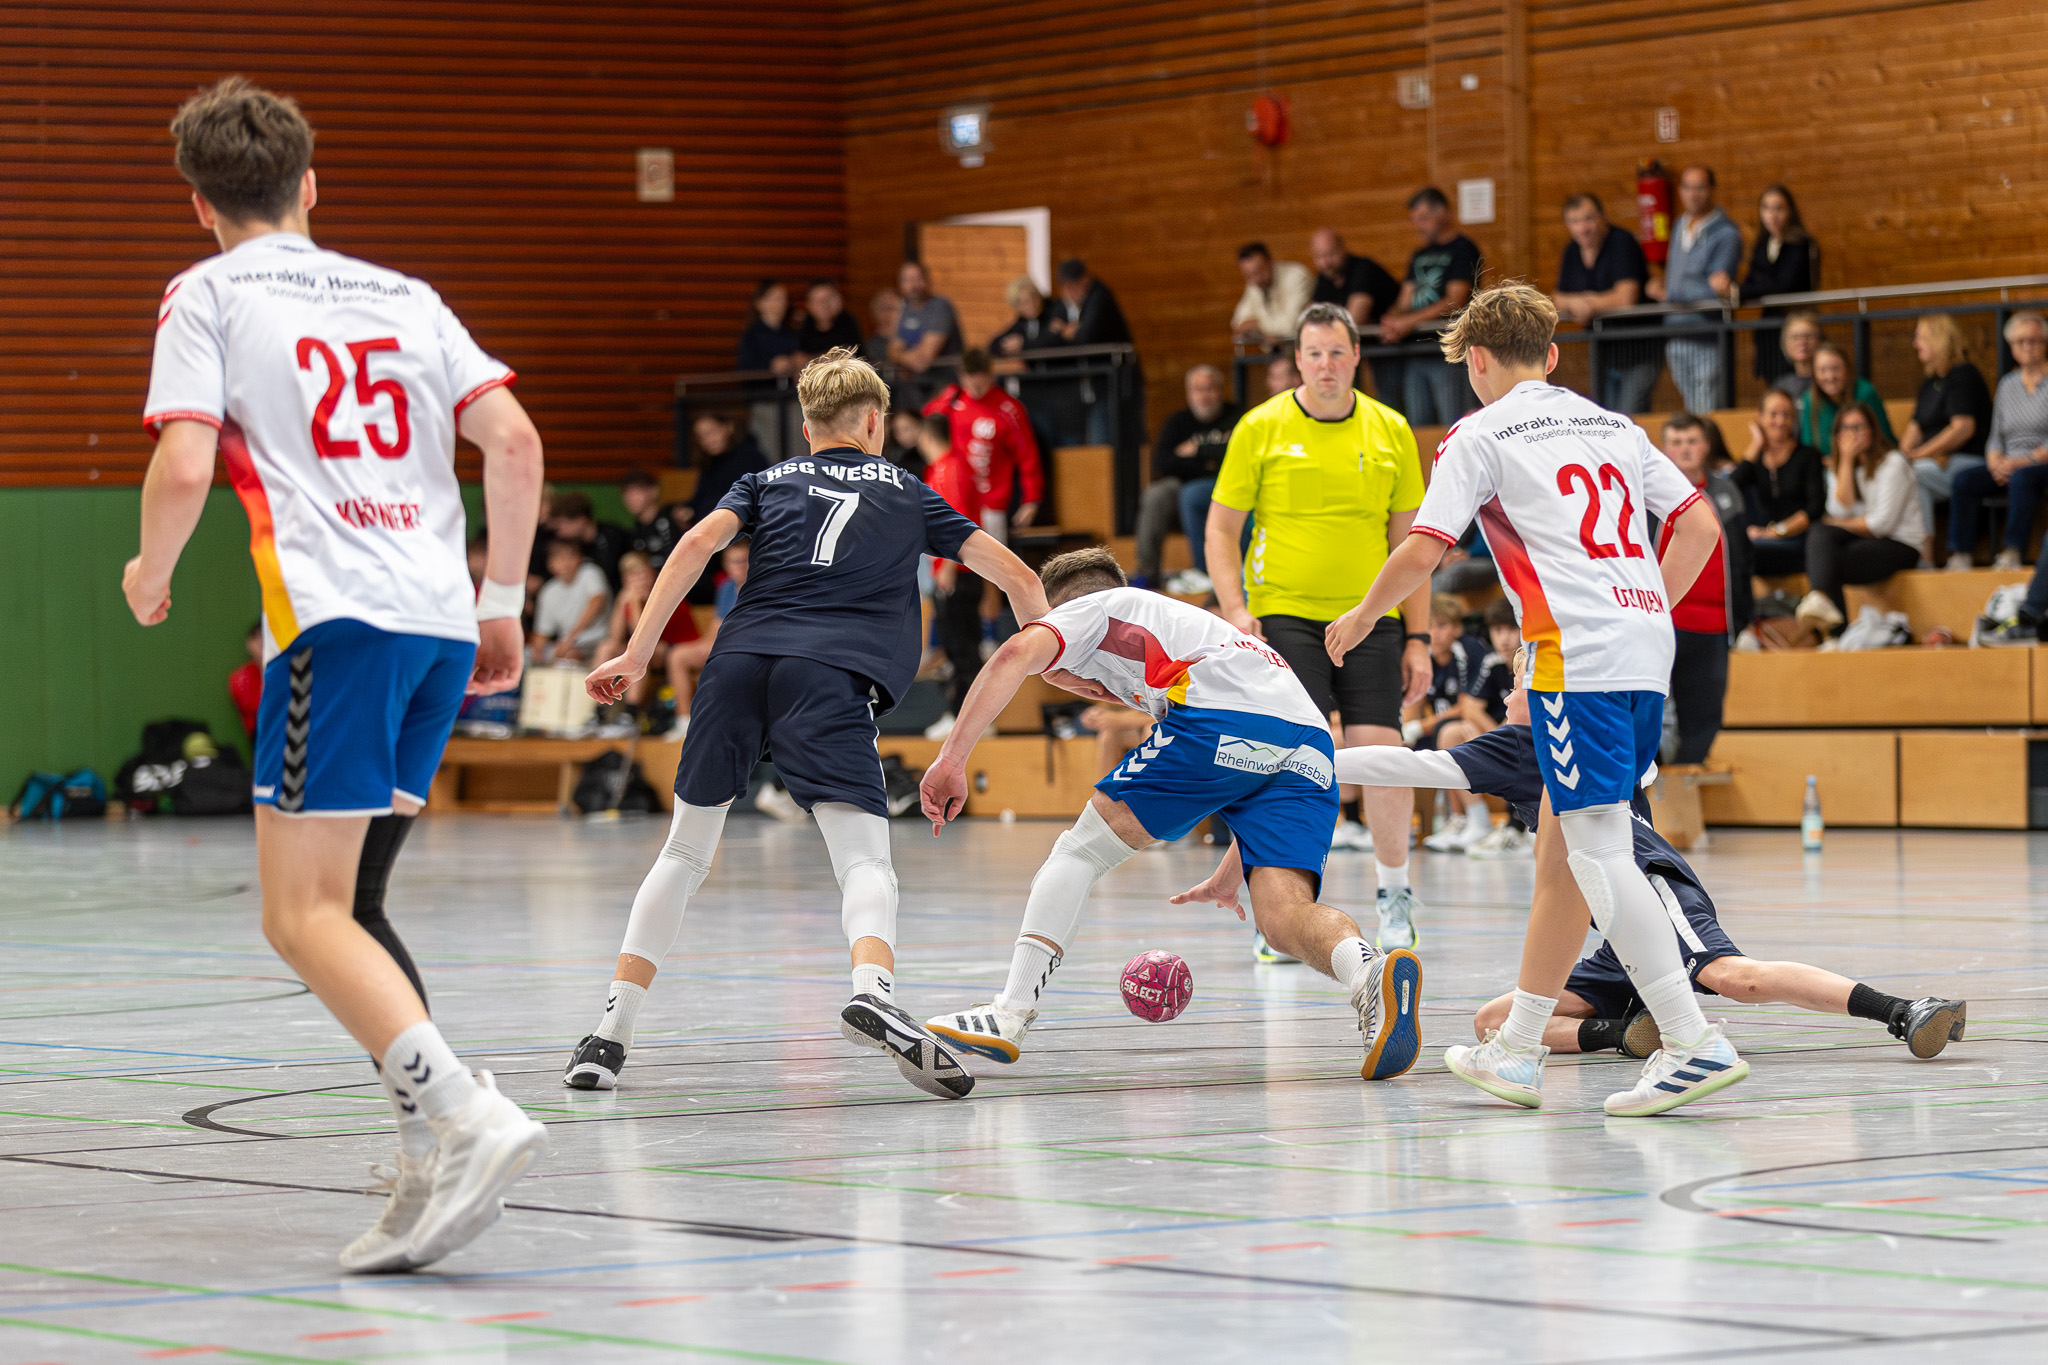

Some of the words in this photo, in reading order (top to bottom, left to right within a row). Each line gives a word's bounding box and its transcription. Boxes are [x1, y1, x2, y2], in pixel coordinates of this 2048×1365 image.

[296, 337, 411, 460] 25
[766, 461, 816, 483] HSG
[821, 463, 904, 491] WESEL
[808, 485, 860, 567] 7
[1556, 462, 1645, 560] 22
[1216, 751, 1332, 788] Rheinwoungsbau
[1123, 979, 1163, 1004] SELECT
